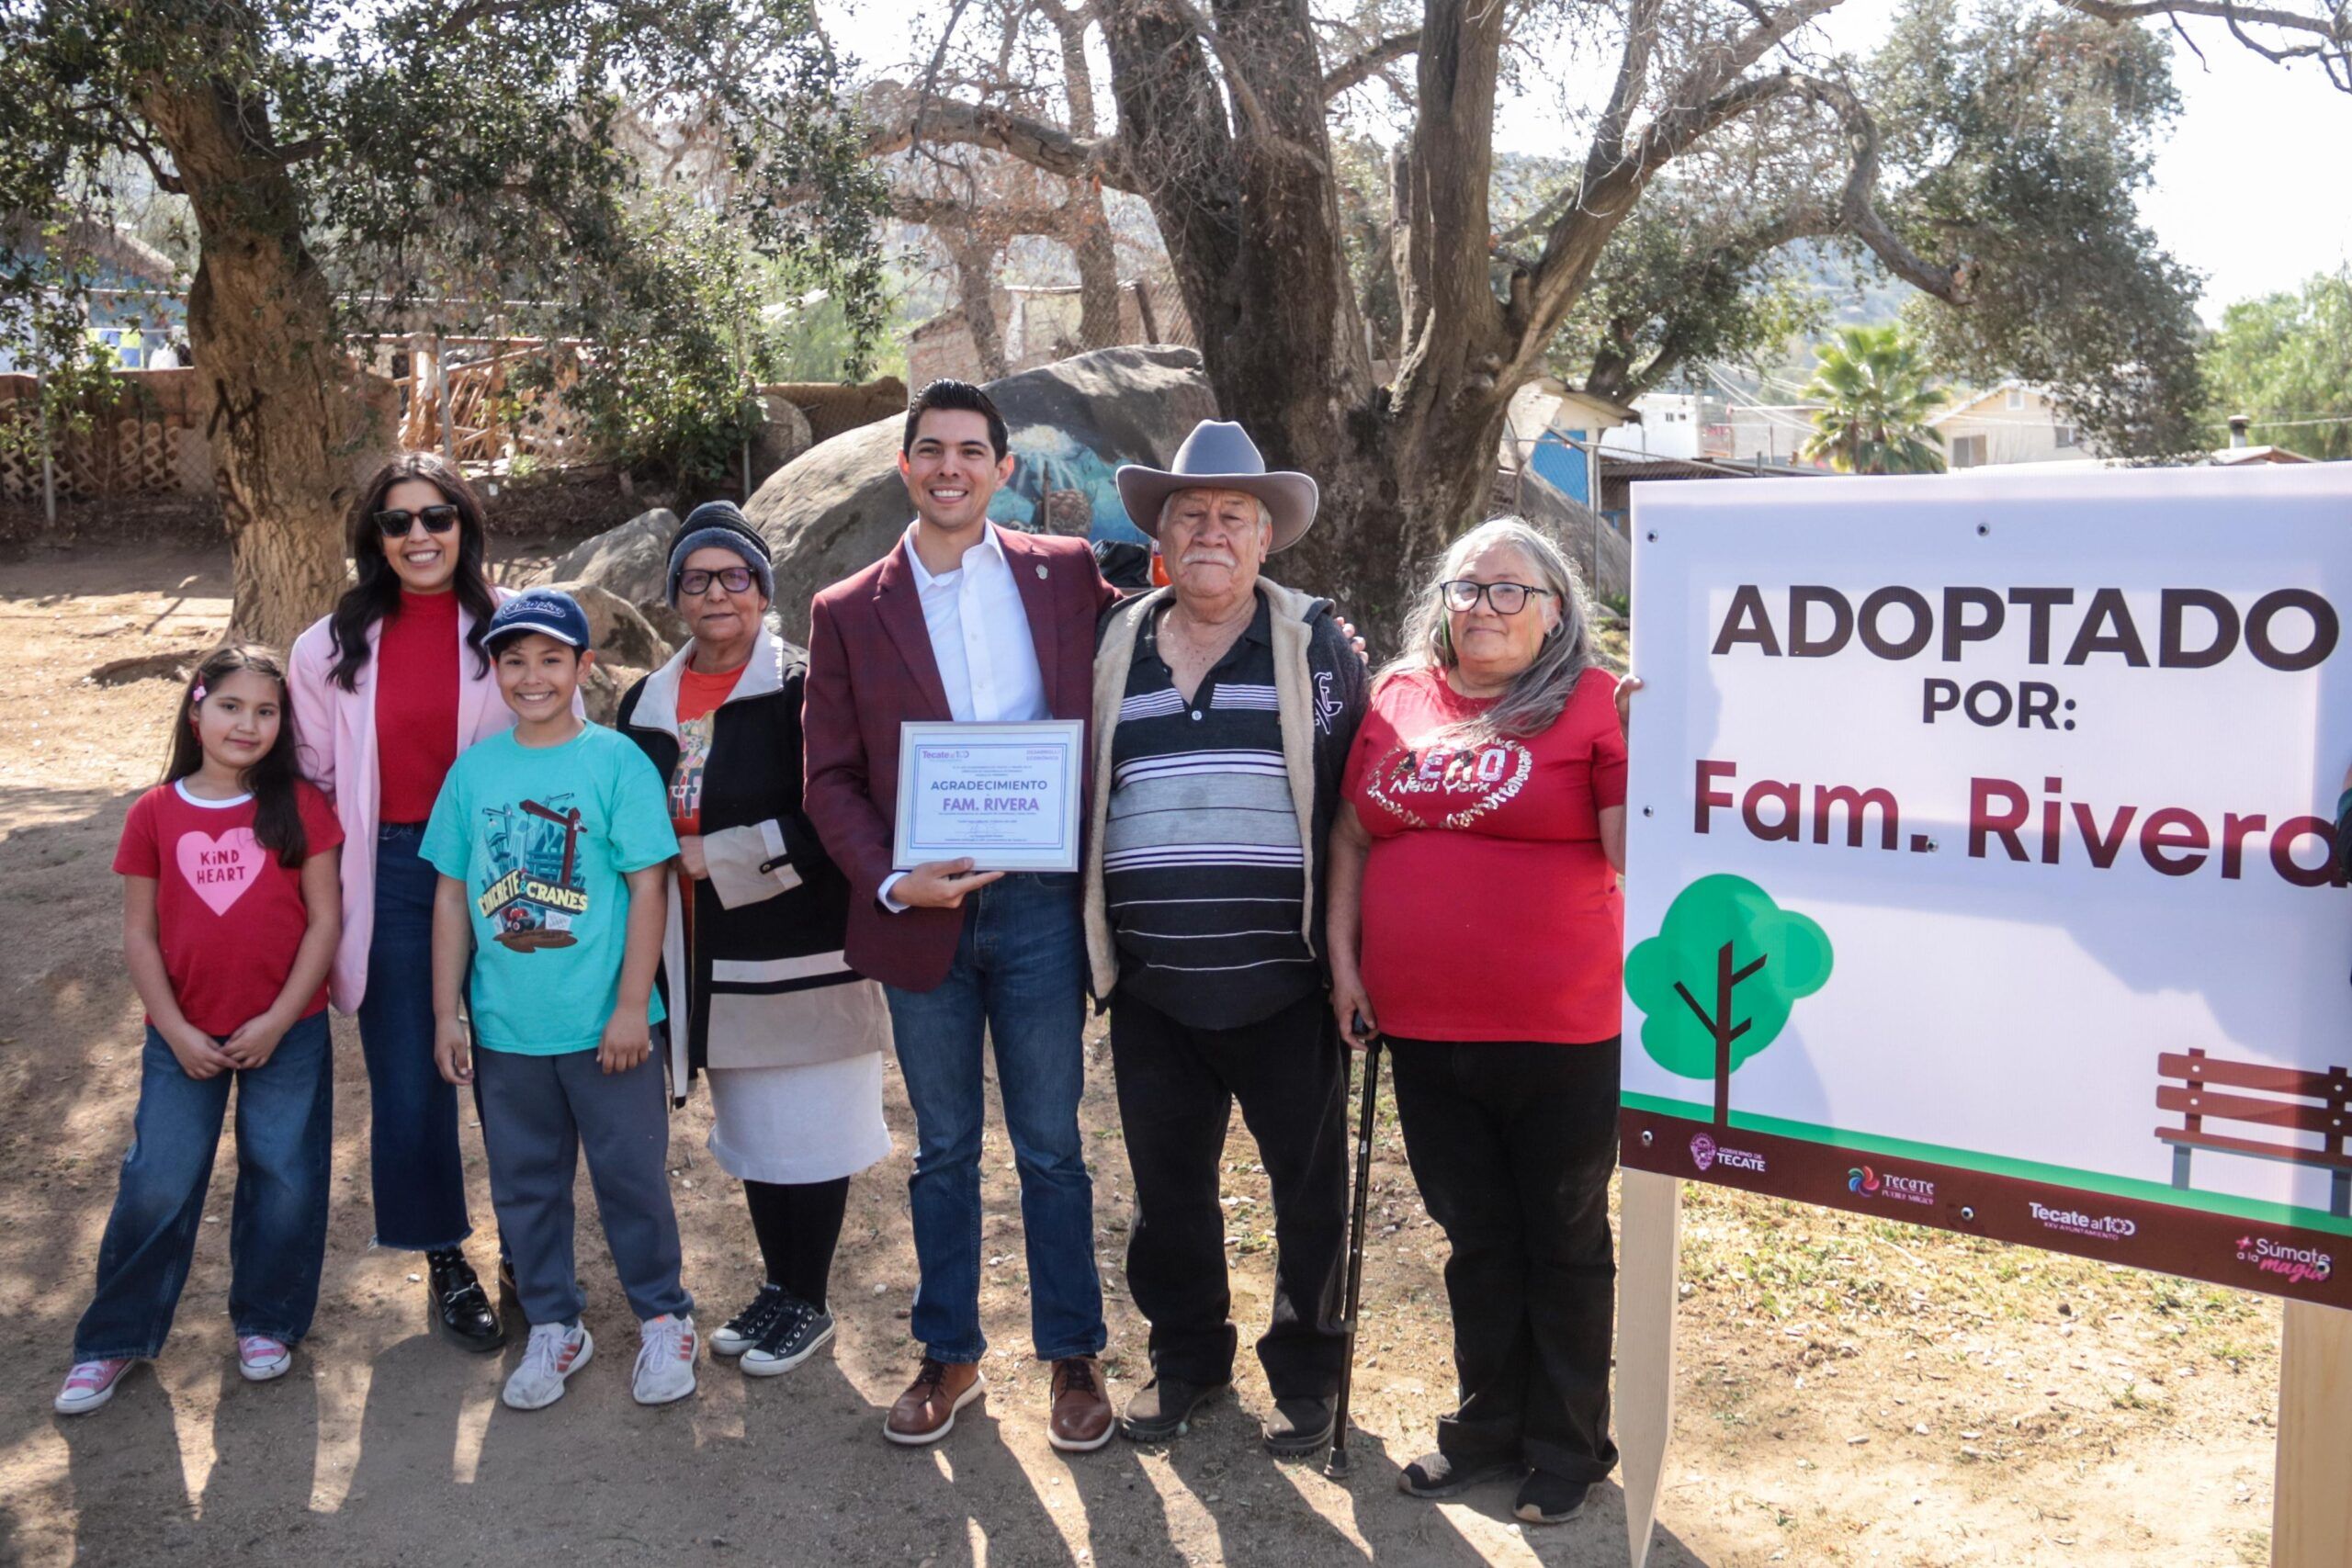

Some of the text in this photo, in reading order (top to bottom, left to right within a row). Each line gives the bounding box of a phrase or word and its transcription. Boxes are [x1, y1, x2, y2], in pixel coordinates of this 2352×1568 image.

[1711, 583, 2339, 672] ADOPTADO
[1922, 677, 2078, 731] POR:
[930, 780, 1048, 791] AGRADECIMIENTO
[1389, 777, 1491, 795] New York
[942, 797, 1040, 811] FAM. RIVERA
[1693, 759, 2347, 888] Fam. Rivera
[197, 866, 246, 885] HEART
[477, 869, 520, 918] CONCRETE
[526, 882, 588, 911] CRANES
[1716, 1152, 1766, 1172] TECATE
[2029, 1201, 2089, 1227] Tecate
[2043, 1222, 2120, 1241] XXV AYUNTAMIENTO
[2236, 1251, 2259, 1263] a la
[2256, 1237, 2331, 1264] Súmate
